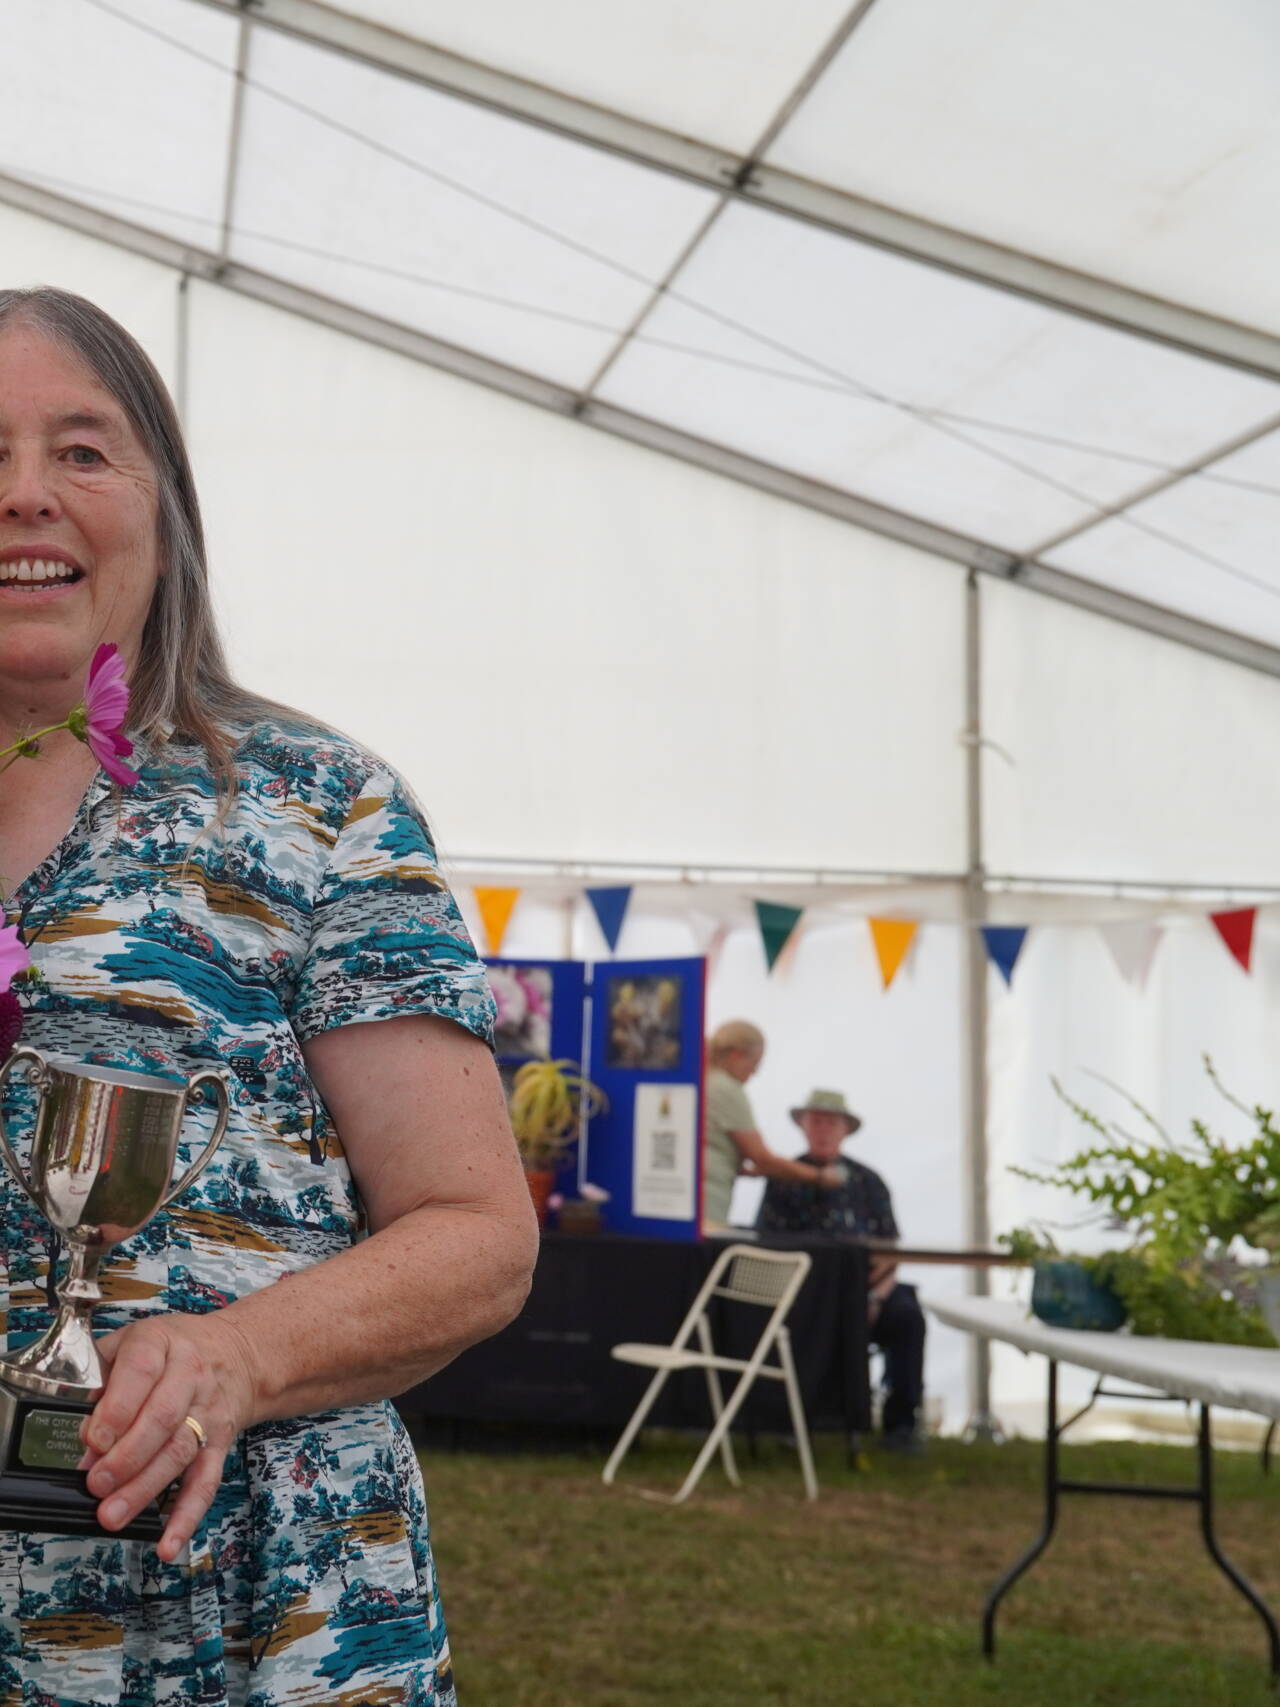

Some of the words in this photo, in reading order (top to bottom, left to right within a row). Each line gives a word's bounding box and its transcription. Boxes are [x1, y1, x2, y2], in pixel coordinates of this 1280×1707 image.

[35, 1417, 50, 1426] THE
[53, 1418, 70, 1427] CITY
[46, 1441, 80, 1451] OVERALL
